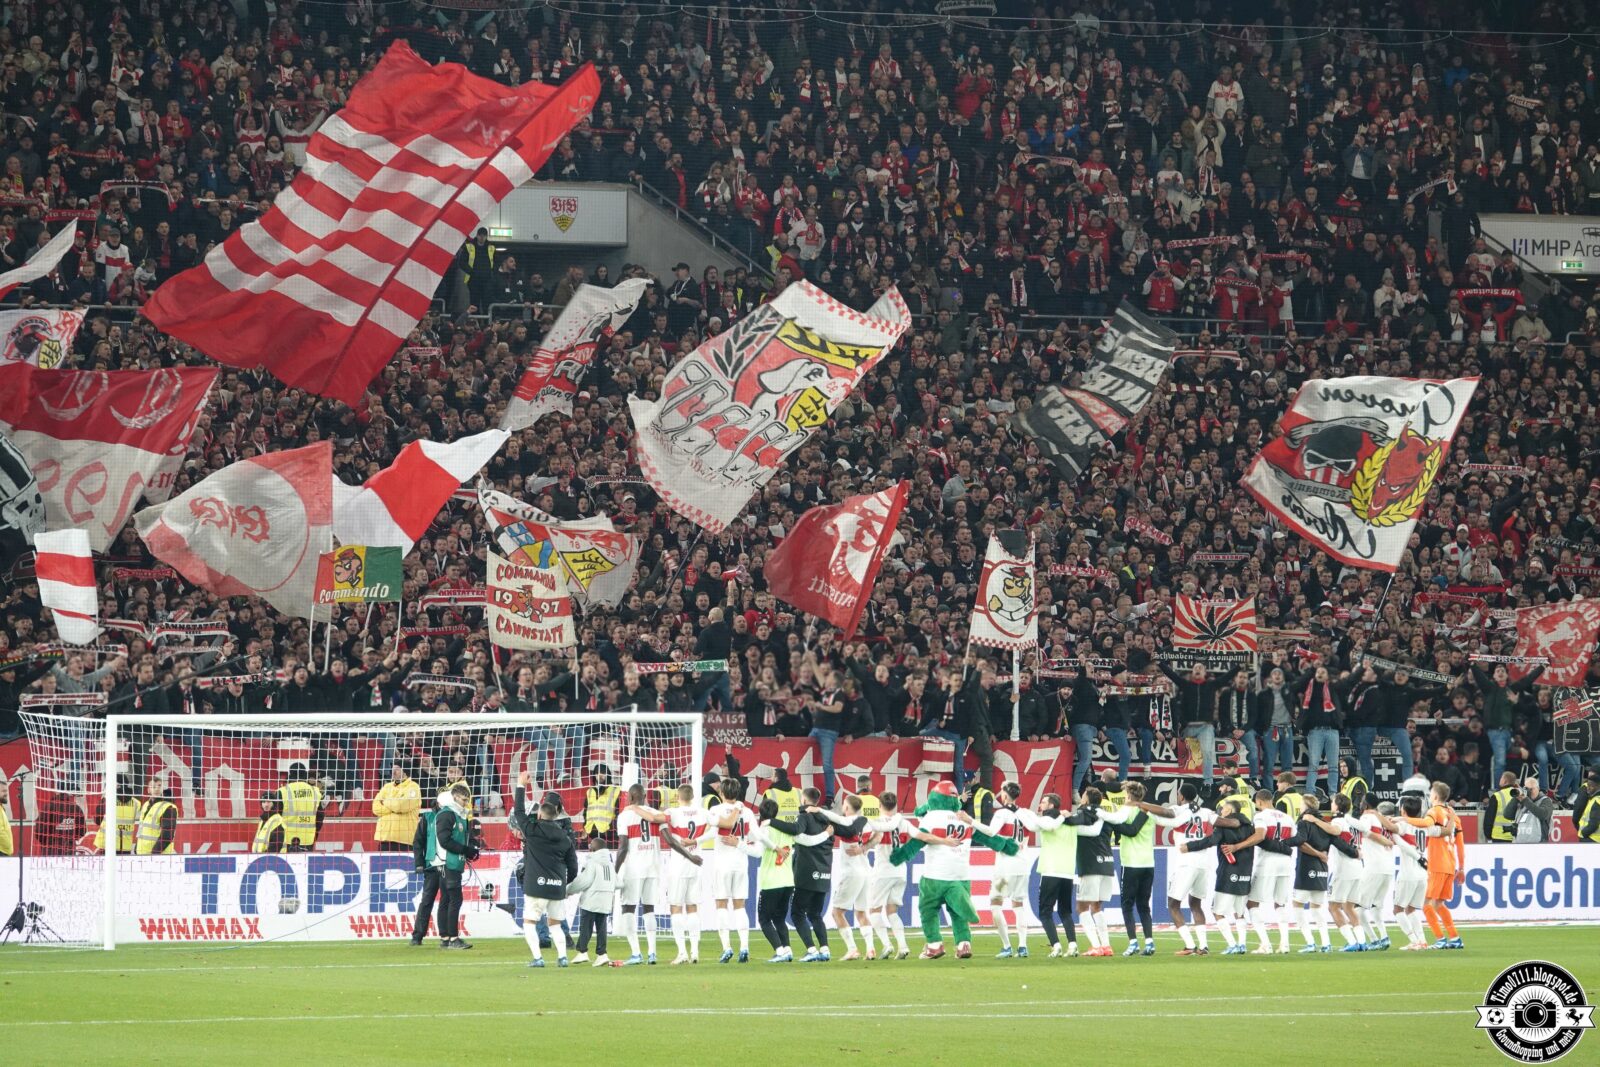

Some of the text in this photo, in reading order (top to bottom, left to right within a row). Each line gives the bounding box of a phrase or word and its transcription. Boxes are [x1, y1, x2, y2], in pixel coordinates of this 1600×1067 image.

[1531, 239, 1570, 256] MHP
[495, 562, 557, 592] COMMANDO
[319, 582, 390, 604] Commando
[494, 589, 560, 614] 19 97
[495, 613, 564, 644] CANNSTATT
[640, 817, 651, 843] 9
[687, 819, 696, 840] 2
[1184, 816, 1204, 839] 23
[1414, 828, 1427, 853] 10
[545, 877, 563, 887] JAKO
[138, 916, 264, 940] WINAMAX
